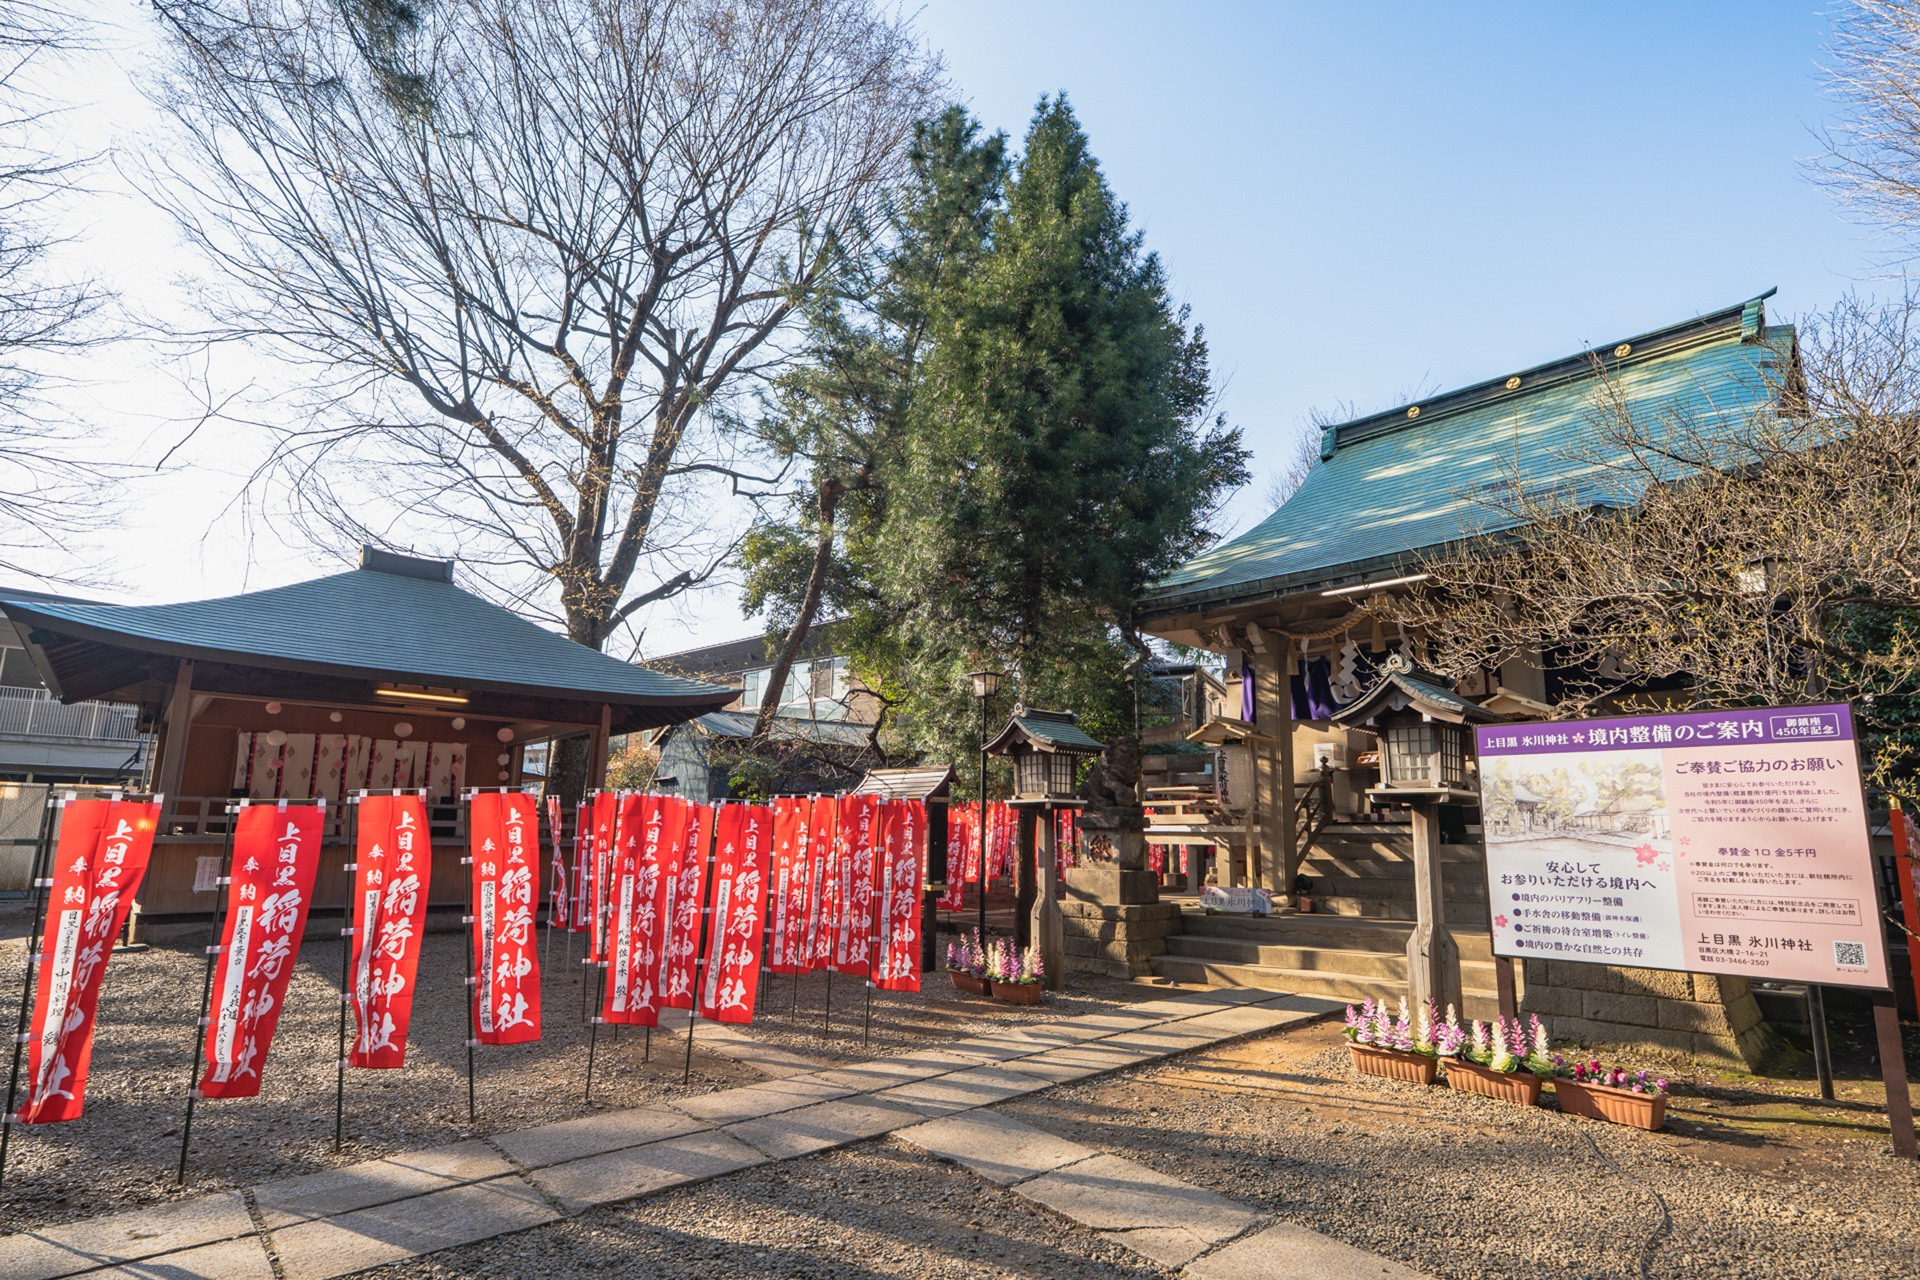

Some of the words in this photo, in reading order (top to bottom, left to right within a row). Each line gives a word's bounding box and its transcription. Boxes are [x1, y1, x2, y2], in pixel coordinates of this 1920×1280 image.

[1484, 736, 1518, 748] 上目黒
[1521, 734, 1569, 747] 氷川神社
[1588, 719, 1763, 746] 境内整備のご案内
[1776, 725, 1834, 736] 450年記念
[1786, 717, 1821, 727] 御鎮座
[1676, 757, 1843, 775] ご奉賛ご協力のお願い
[366, 844, 384, 886] 奉納
[481, 838, 496, 877] 奉納
[624, 835, 636, 871] 奉納
[720, 842, 734, 876] 奉納
[1546, 861, 1601, 874] 安心して
[1718, 847, 1751, 857] 奉賛金
[1754, 848, 1771, 856] 1口
[1775, 848, 1817, 858] 金5千円
[64, 856, 88, 905] 奉納
[240, 856, 259, 901] 奉納
[847, 804, 873, 965] 上目黒稲荷神社
[1501, 873, 1657, 890] お参りいただける境内へ
[626, 810, 662, 1013] 上目黒稲荷神社
[668, 818, 701, 998] 上目黒稲荷神社
[890, 812, 917, 981] 上目黒稲荷神社
[1521, 893, 1624, 907] 境内のバリアフリー整備
[494, 807, 534, 1032] 上目黒稲荷神社
[716, 818, 761, 1011] 上目黒稲荷神社
[369, 811, 420, 1054] 上目黒稲荷神社
[1525, 940, 1644, 958] 境内の豊かな自然との共存
[1697, 933, 1742, 946] 上目黒
[1748, 936, 1814, 951] 氷川神社
[229, 822, 302, 1082] 上目黒稲荷神社
[1698, 946, 1735, 956] 目黒区大橋
[1700, 955, 1715, 963] 電話
[1715, 956, 1770, 966] 03-3466-2507
